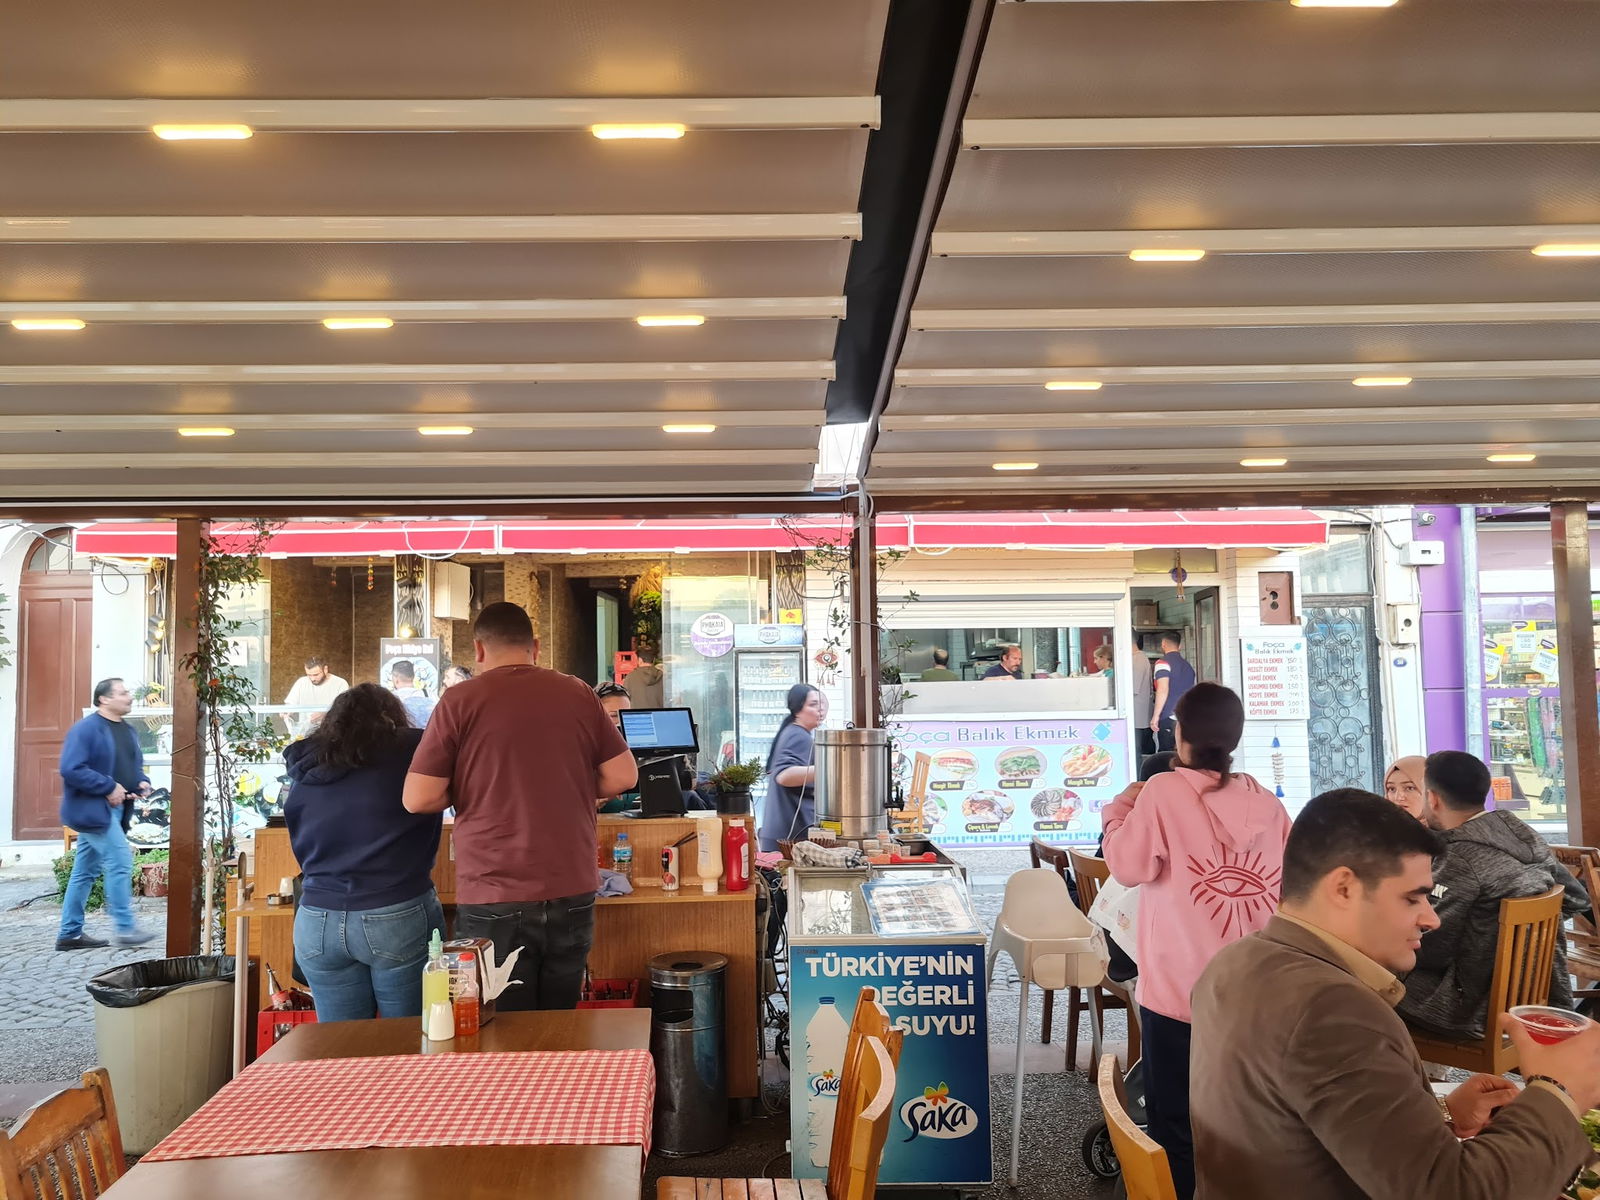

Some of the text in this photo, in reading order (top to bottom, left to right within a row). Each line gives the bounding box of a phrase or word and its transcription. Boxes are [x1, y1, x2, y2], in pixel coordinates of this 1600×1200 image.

[957, 727, 1007, 742] Balık
[1014, 725, 1079, 740] Ekmek
[895, 1015, 976, 1036] SUYU!
